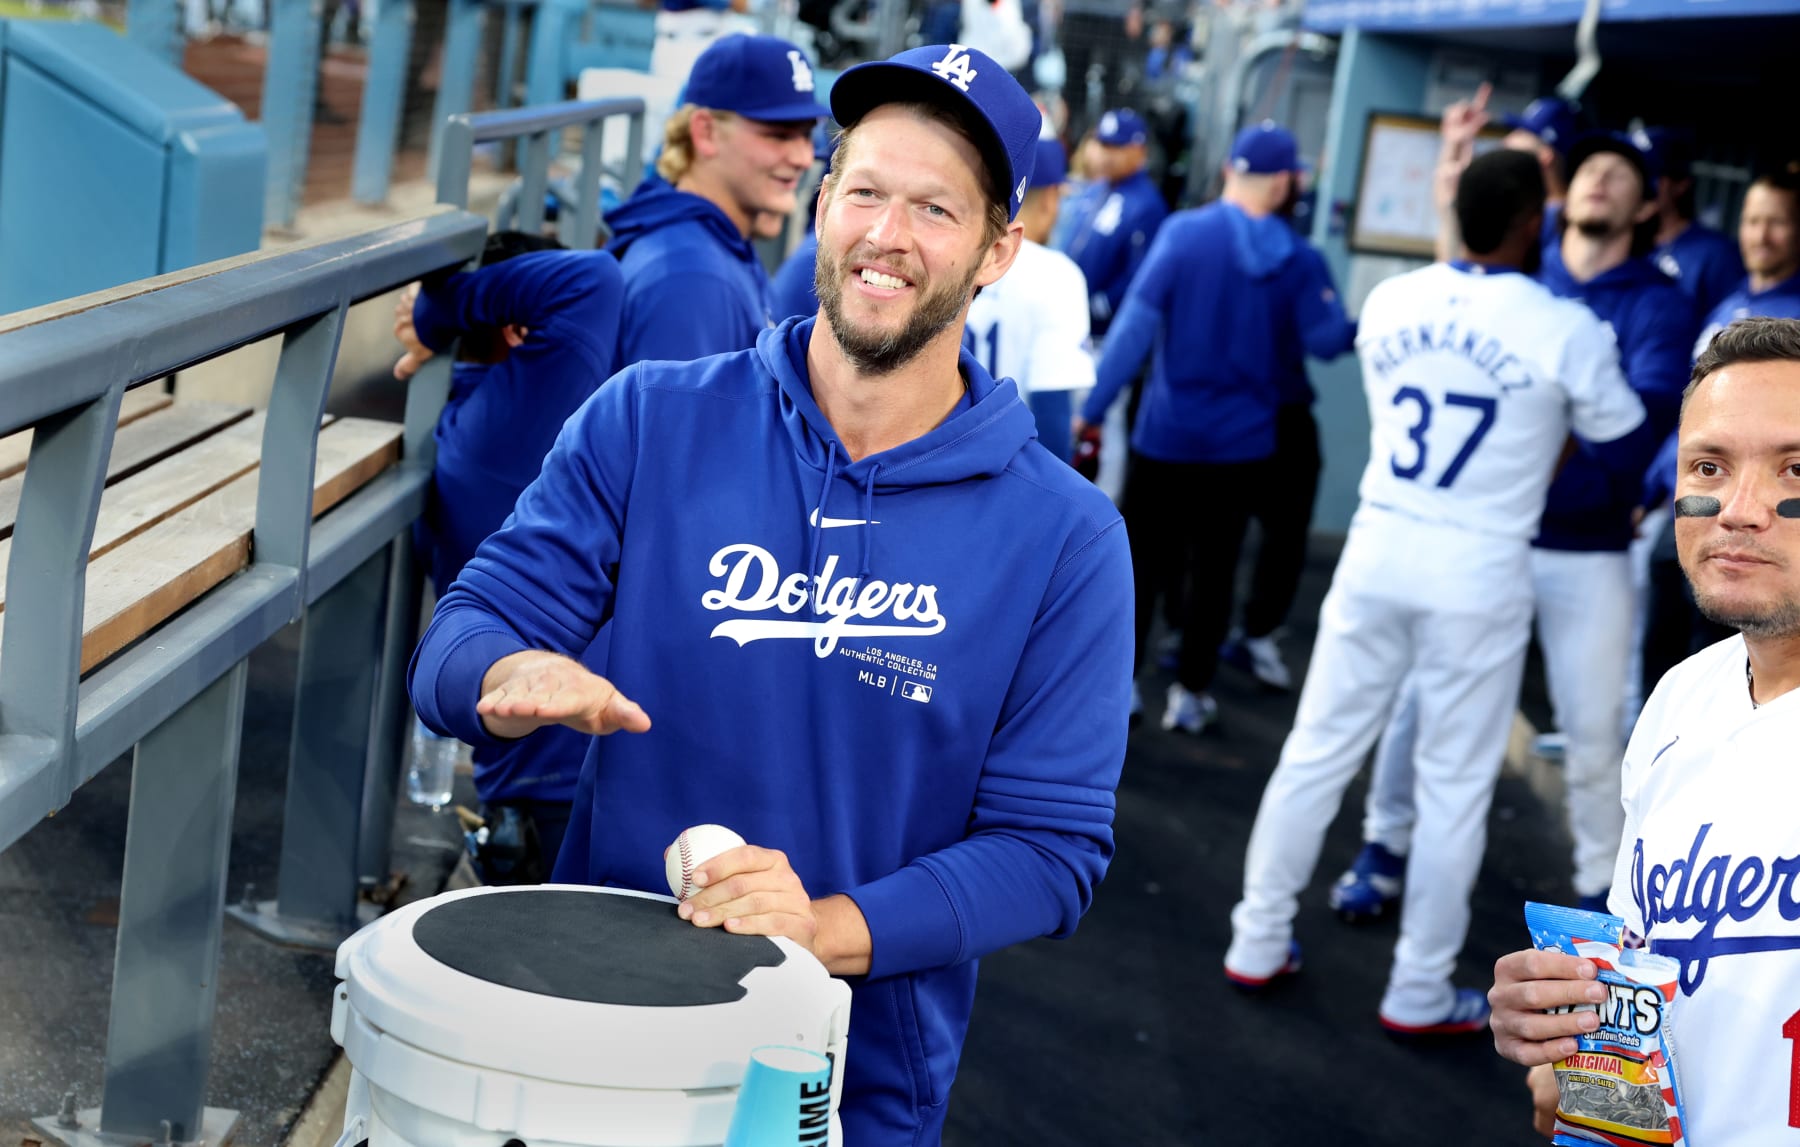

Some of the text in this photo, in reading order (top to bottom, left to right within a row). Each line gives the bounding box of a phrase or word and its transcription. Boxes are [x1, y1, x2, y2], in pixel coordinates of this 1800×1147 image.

[787, 50, 815, 92] LA
[931, 44, 977, 92] LA
[1391, 385, 1499, 489] 37
[701, 543, 947, 659] Dodgers
[839, 647, 937, 681] AUTHENTIC COLLECTION
[866, 646, 882, 657] LOS
[926, 663, 938, 673] CA
[858, 670, 887, 688] MLB
[1618, 1032, 1641, 1047] Seeds
[1564, 1053, 1623, 1076] ORIGINAL
[1597, 1078, 1616, 1089] SALTED
[798, 1082, 829, 1147] IME
